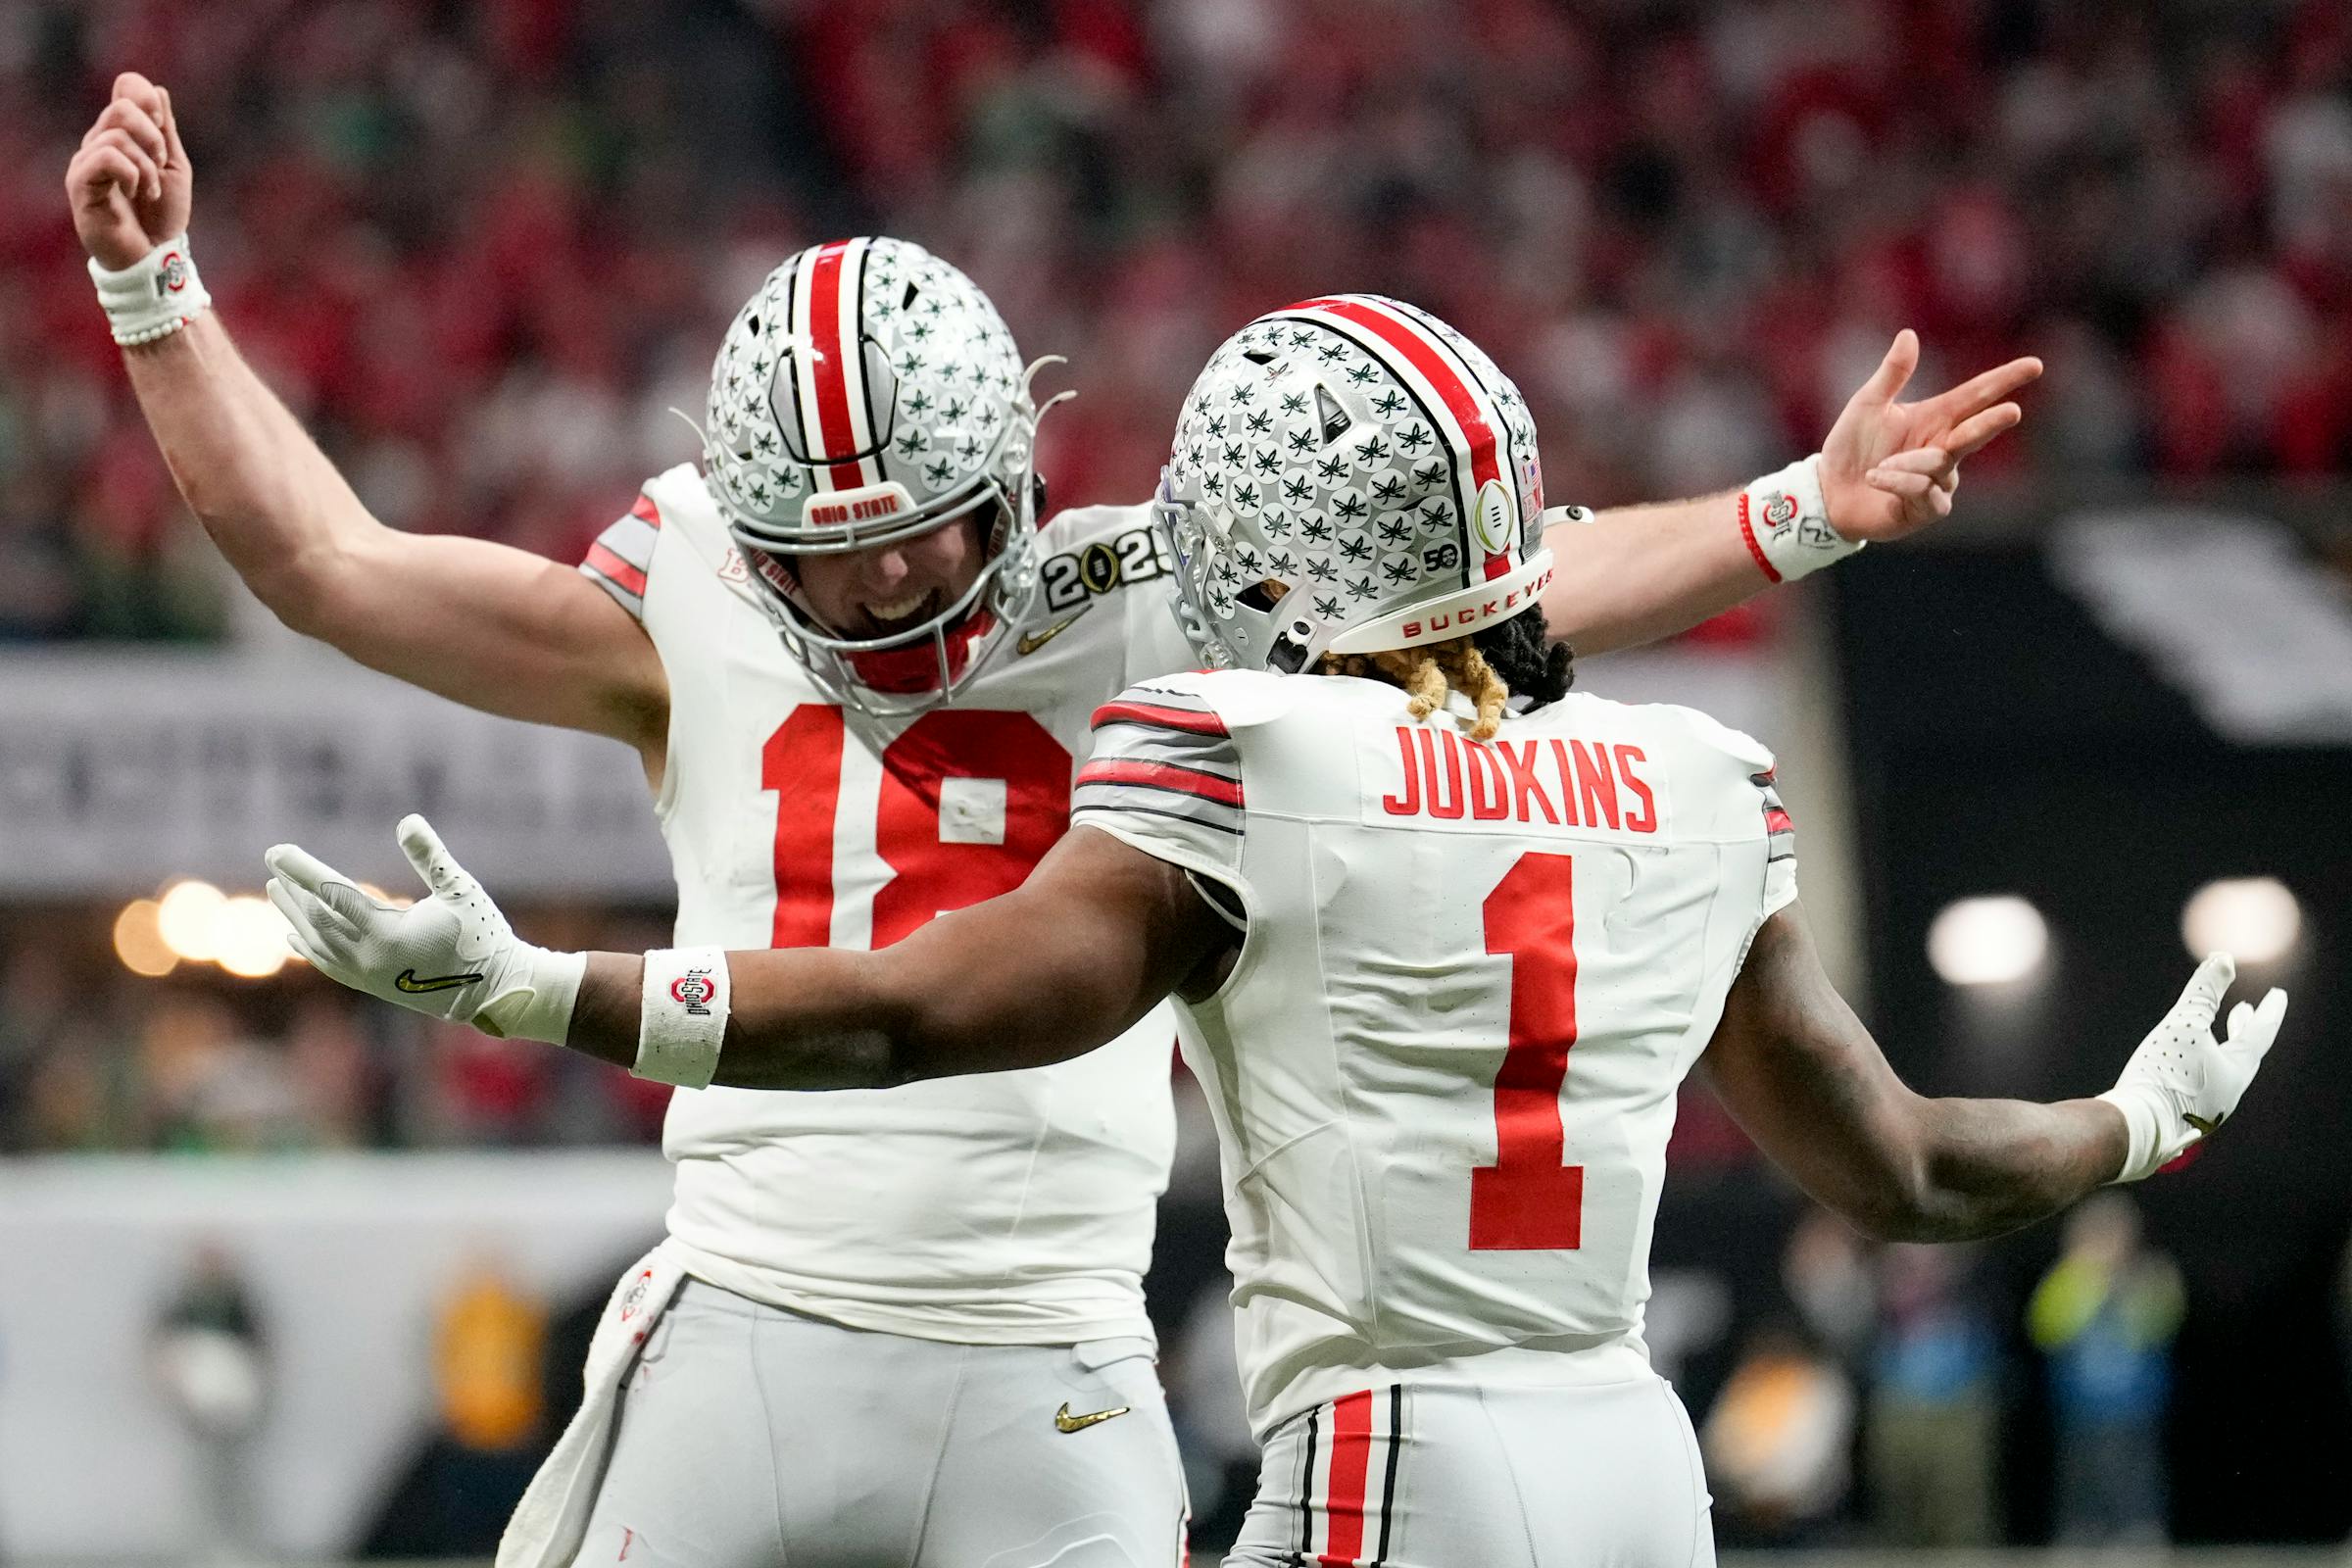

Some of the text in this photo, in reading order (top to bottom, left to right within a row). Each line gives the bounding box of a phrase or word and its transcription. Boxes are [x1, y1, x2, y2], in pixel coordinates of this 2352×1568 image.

[811, 494, 898, 525] OHIO STATE
[1402, 568, 1552, 638] BUCKEYES
[761, 703, 1073, 950] 18
[1383, 726, 1657, 833] JUDKINS
[1469, 852, 1585, 1250] 1
